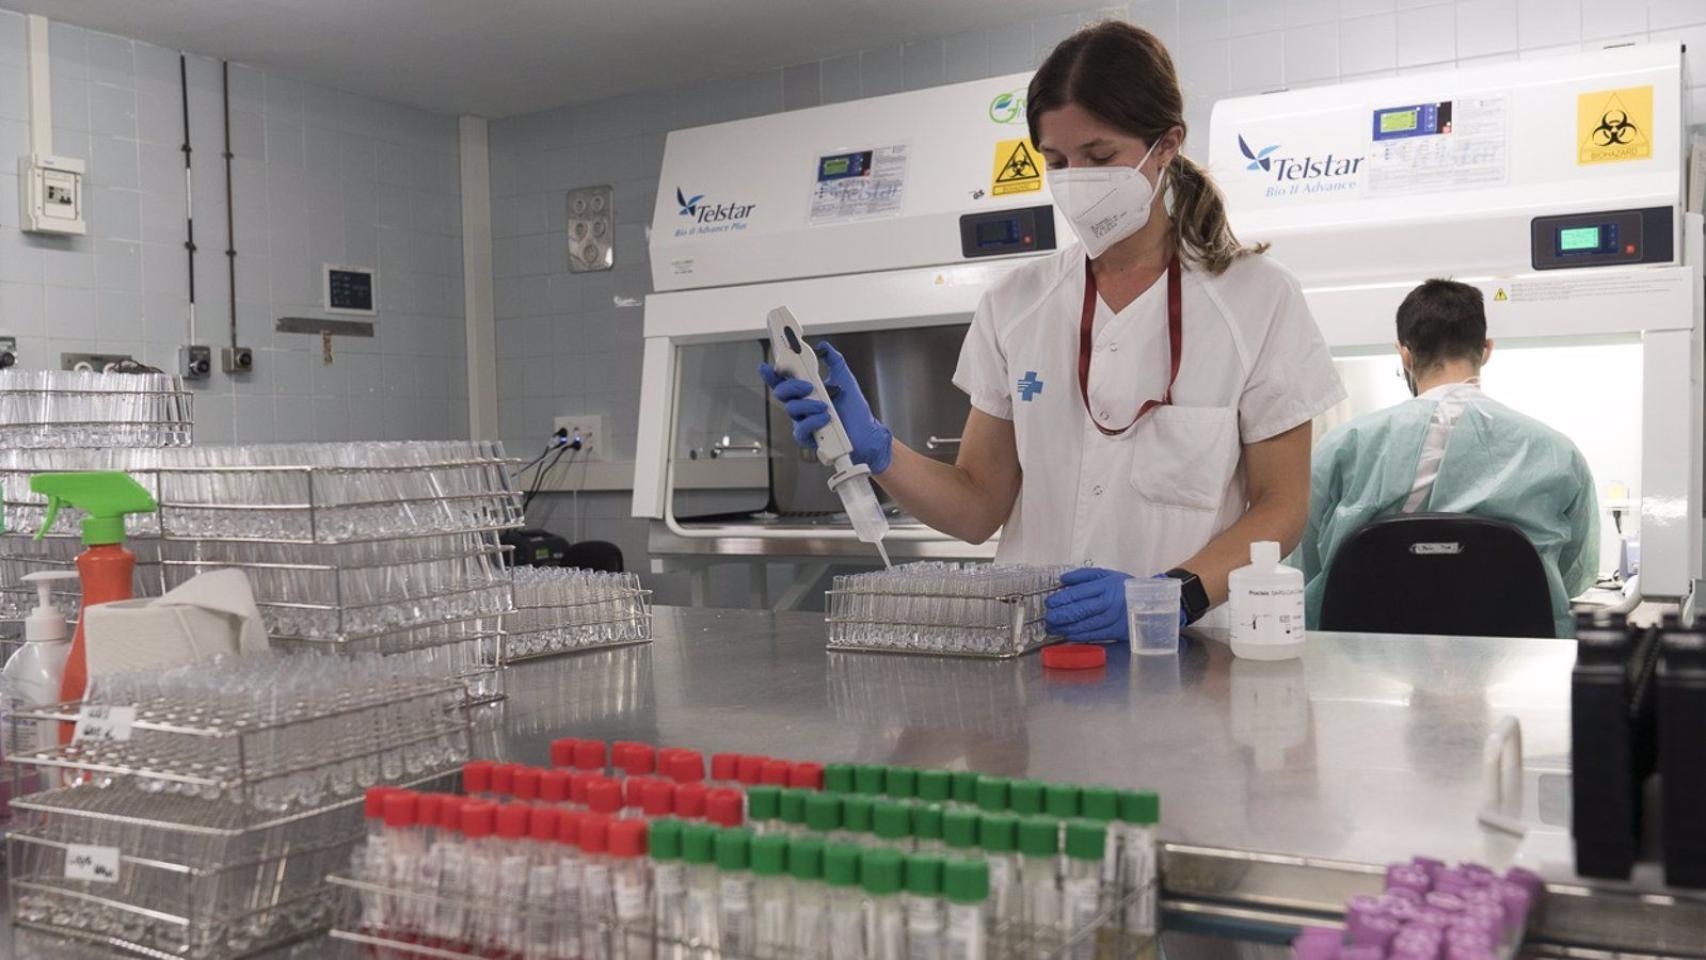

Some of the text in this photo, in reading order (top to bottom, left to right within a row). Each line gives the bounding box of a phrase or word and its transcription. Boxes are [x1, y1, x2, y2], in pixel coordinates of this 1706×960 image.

[1273, 153, 1365, 181] Telstar
[1265, 186, 1286, 198] Bio
[1303, 181, 1357, 194] Advance
[697, 202, 757, 224] Telstar
